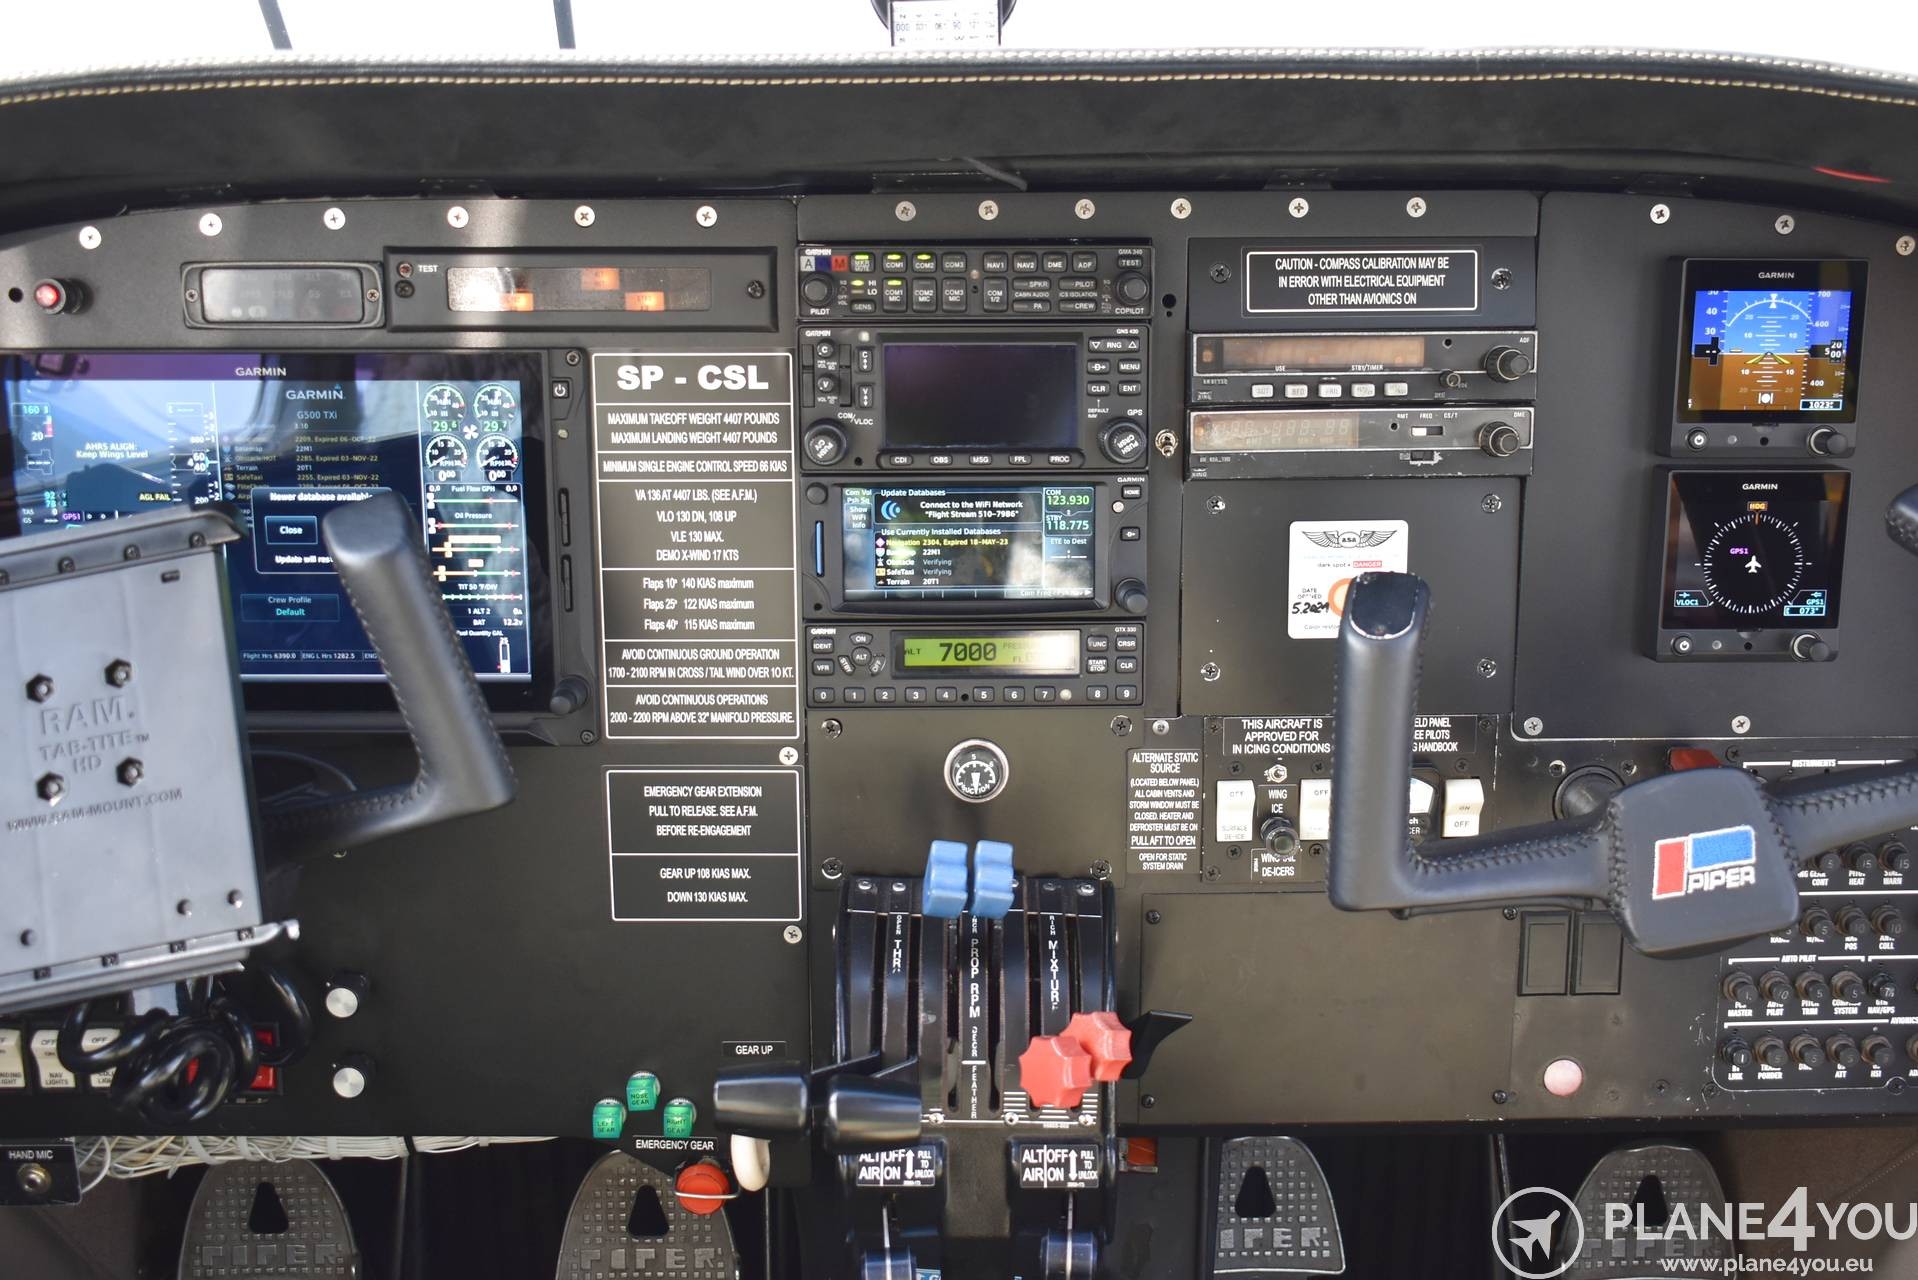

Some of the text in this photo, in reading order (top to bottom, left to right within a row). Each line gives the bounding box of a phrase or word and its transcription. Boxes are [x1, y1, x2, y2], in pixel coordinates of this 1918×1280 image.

[1275, 257, 1313, 270] CAUTION
[1319, 257, 1360, 270] COMPASS
[1362, 257, 1417, 270] CALIBRATION
[1418, 257, 1437, 270] MAY
[1437, 257, 1449, 270] BE
[418, 265, 439, 273] TEST
[1278, 274, 1446, 288] IN ERROR WITH ELECTRICAL EQUIPMENT
[1308, 293, 1417, 306] OTHER THAN AVIONICS ON
[235, 367, 287, 377] GARMIN
[1120, 363, 1140, 371] MENU
[616, 365, 769, 391] SP - CSL
[285, 390, 344, 400] GARMIN
[608, 413, 780, 425] MAXIMUM TAKEOFF WEIGHT 4407 POUNDS
[76, 451, 148, 460] Keep Wings Level
[894, 456, 908, 464] CDI
[972, 456, 989, 464] MSG
[1049, 456, 1070, 464] PROC
[603, 461, 787, 473] MINIMUM SINGLE ENGINE CONTROL SPEED 66 KIAS
[1742, 483, 1778, 491] GARMIN
[269, 492, 296, 501] Newer
[297, 492, 335, 501] database
[635, 489, 757, 502] VA 136 AT 4407 LBS. (SEE A.F.M.)
[880, 489, 946, 498] Update Databases
[920, 501, 1023, 509] Connect to the WiFi Network
[1046, 496, 1090, 506] 123.930
[949, 510, 976, 519] Stream
[279, 525, 303, 535] Close
[1046, 521, 1089, 531] 118.775
[942, 538, 968, 546] Expired
[1729, 547, 1749, 555] GPS1
[642, 577, 664, 591] Flaps
[681, 577, 696, 589] 140
[697, 577, 717, 589] KIAS
[718, 577, 754, 589] maximum
[268, 596, 312, 604] Crew Profile
[276, 608, 306, 617] Default
[622, 648, 780, 660] AVOID CONTINUOUS GROUND OPERATION
[938, 642, 997, 662] 7000
[1241, 719, 1323, 730] THIS AIRCRAFT IS
[1429, 718, 1451, 728] PANEL
[1244, 731, 1319, 742] APPROVED FOR
[1232, 743, 1331, 754] IN ICING CONDITIONS
[1420, 741, 1458, 752] HANDBOOK
[1132, 752, 1199, 763] ALTERNATE STATIC
[1150, 763, 1181, 773] SOURCE
[644, 786, 762, 798] EMERGENCY GEAR EXTENSION
[1268, 789, 1288, 799] WING
[649, 805, 758, 817] PULL TO RELEASE. SEE A.F.M.
[1271, 804, 1284, 813] ICE
[656, 825, 752, 836] BEFORE RE-ENGAGEMENT
[1131, 836, 1196, 846] PULL AFT TO OPEN
[1687, 865, 1756, 894] PIPER
[1781, 955, 1817, 963] AUTO PILOT
[969, 938, 980, 1018] PROP RPM
[735, 1044, 773, 1055] GEAR UP
[635, 1139, 714, 1150] EMERGENCY GEAR
[8, 1150, 54, 1159] HAND MIC
[1022, 1149, 1069, 1163] ALT OFF
[1022, 1167, 1064, 1182] AIR ON
